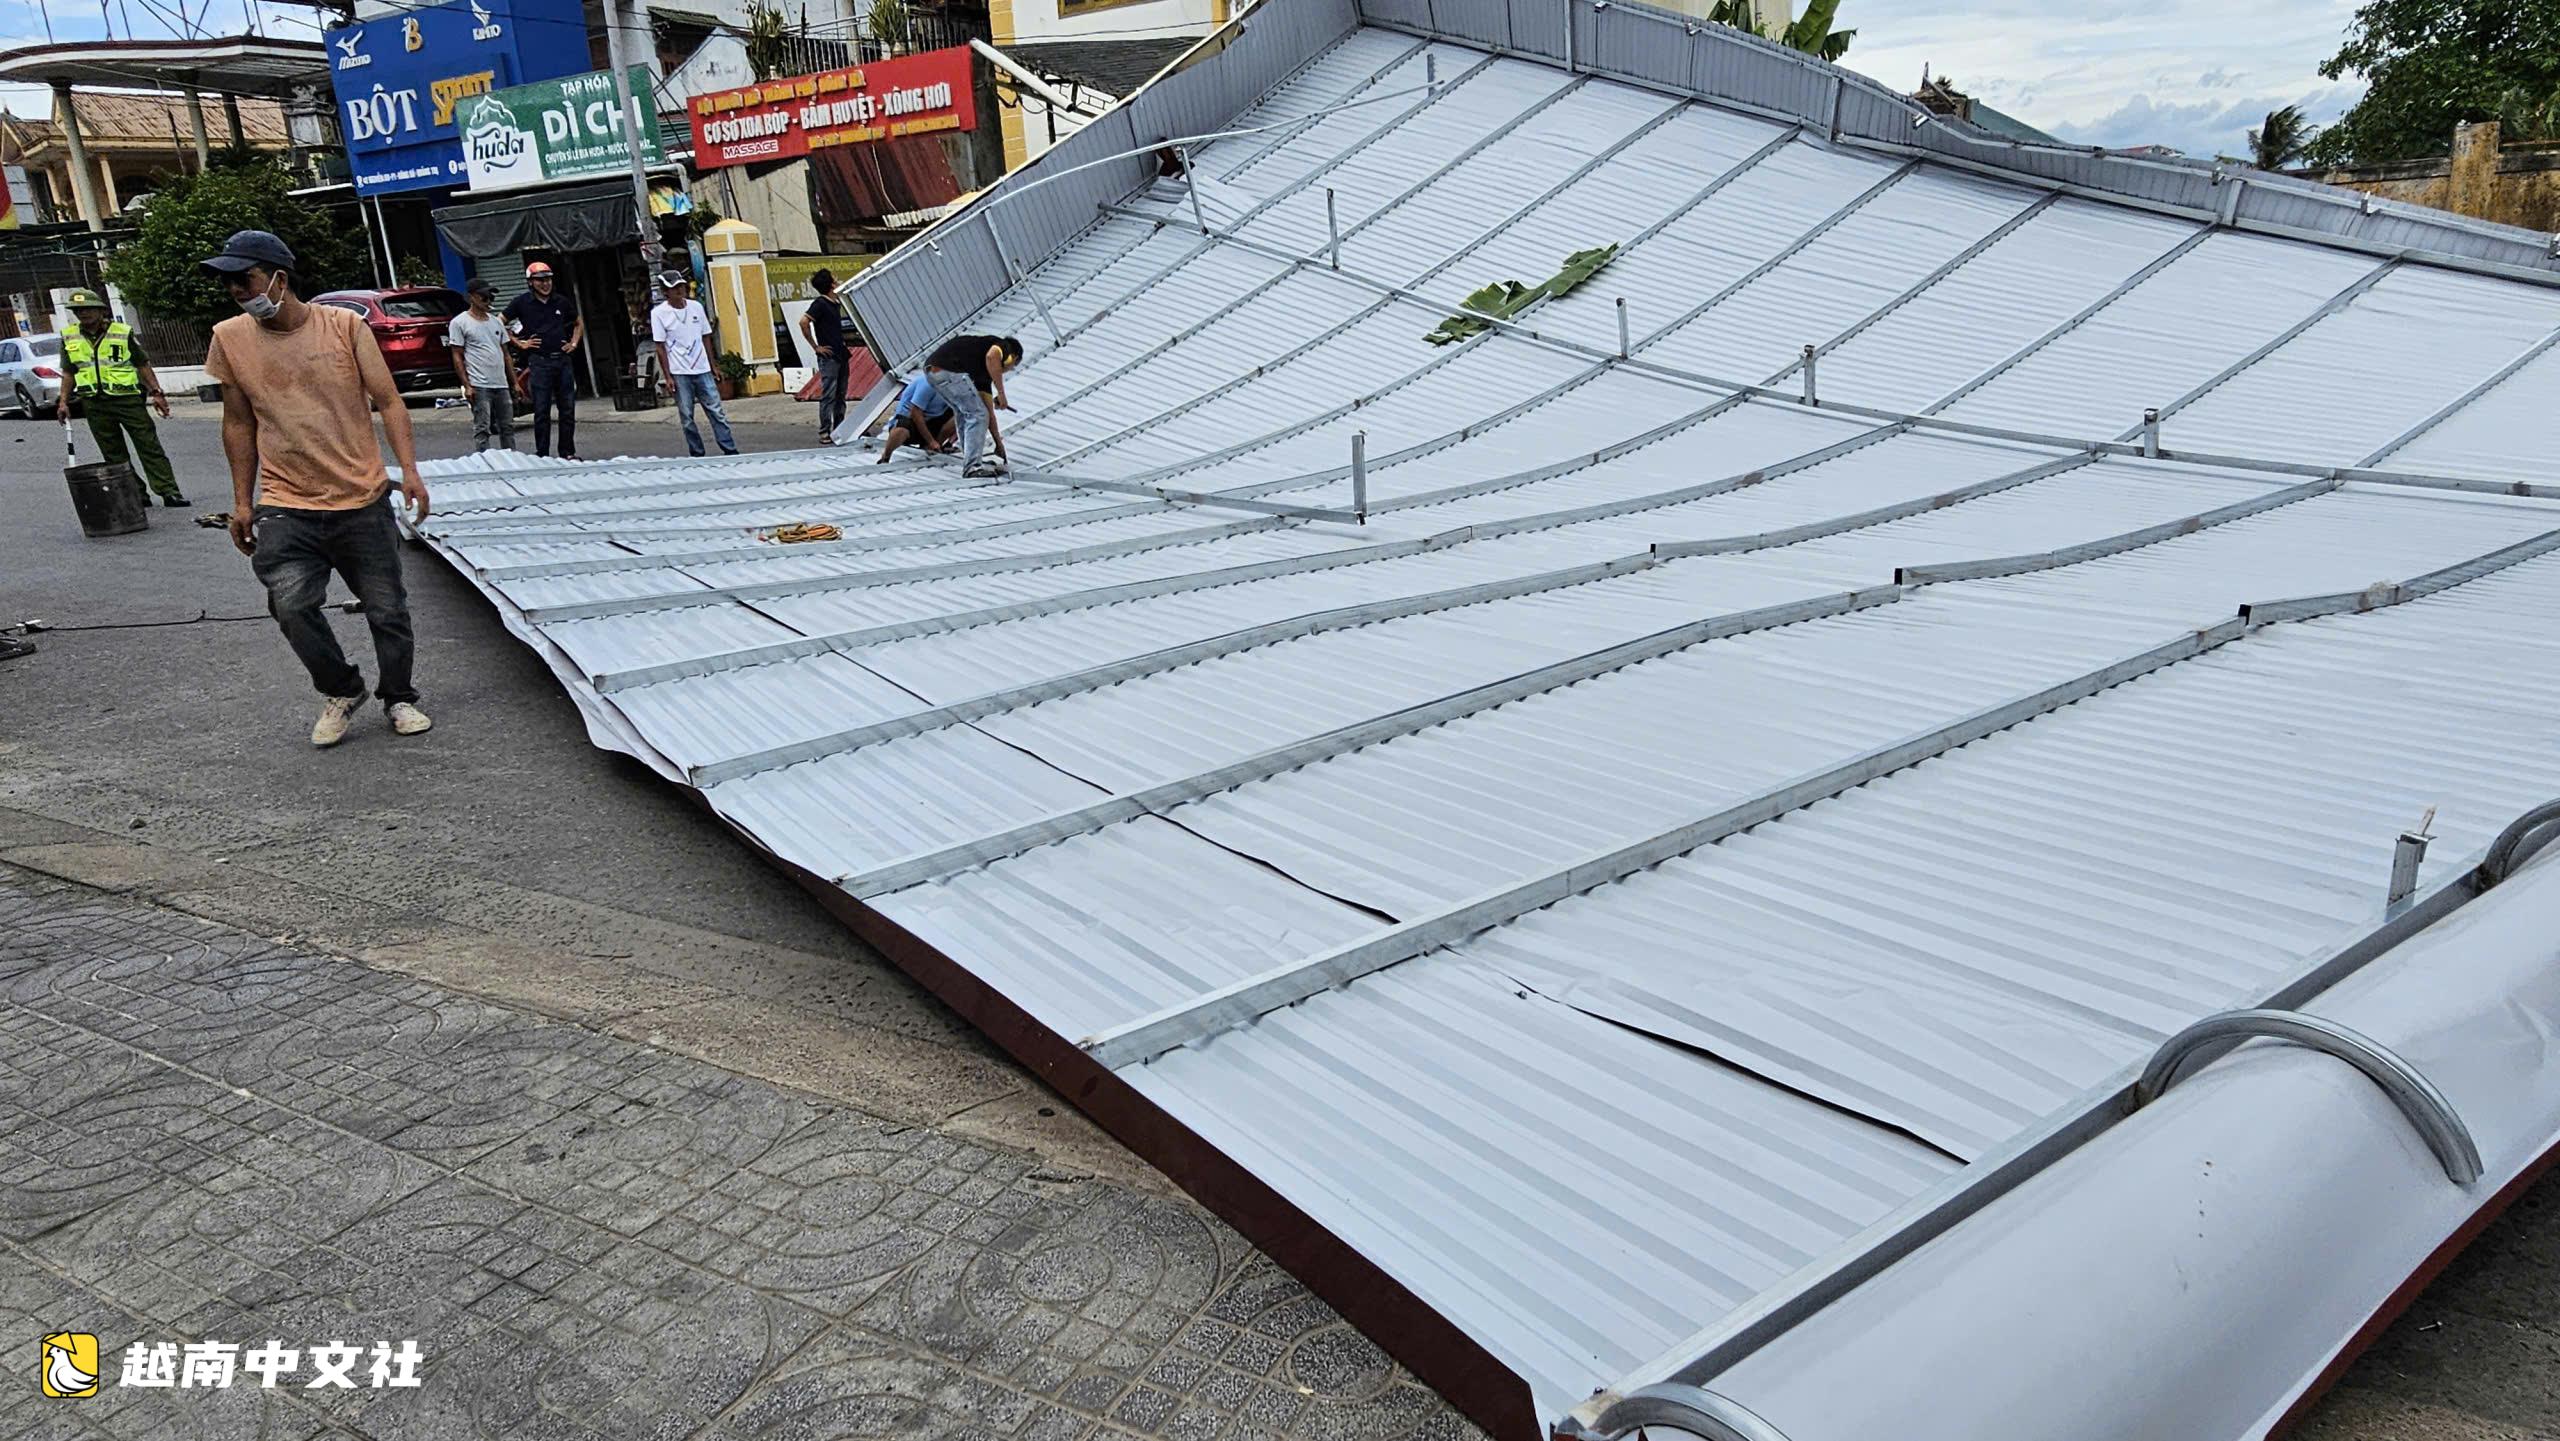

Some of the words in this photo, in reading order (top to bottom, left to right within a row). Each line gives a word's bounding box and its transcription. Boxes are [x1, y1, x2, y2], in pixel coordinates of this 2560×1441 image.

[560, 81, 582, 97] TẠP
[583, 75, 611, 94] HÓA
[346, 83, 418, 145] BỘT
[542, 100, 580, 143] DÌ
[703, 121, 723, 145] CƠ
[721, 109, 741, 143] SỞ
[739, 115, 765, 140] XOA
[764, 107, 790, 135] BÓP
[800, 94, 831, 130] BẤM
[830, 92, 876, 128] HUYỆT
[882, 86, 924, 117] XÔNG
[924, 81, 952, 108] HƠI
[472, 131, 524, 161] huda
[724, 141, 778, 158] MASSAGE
